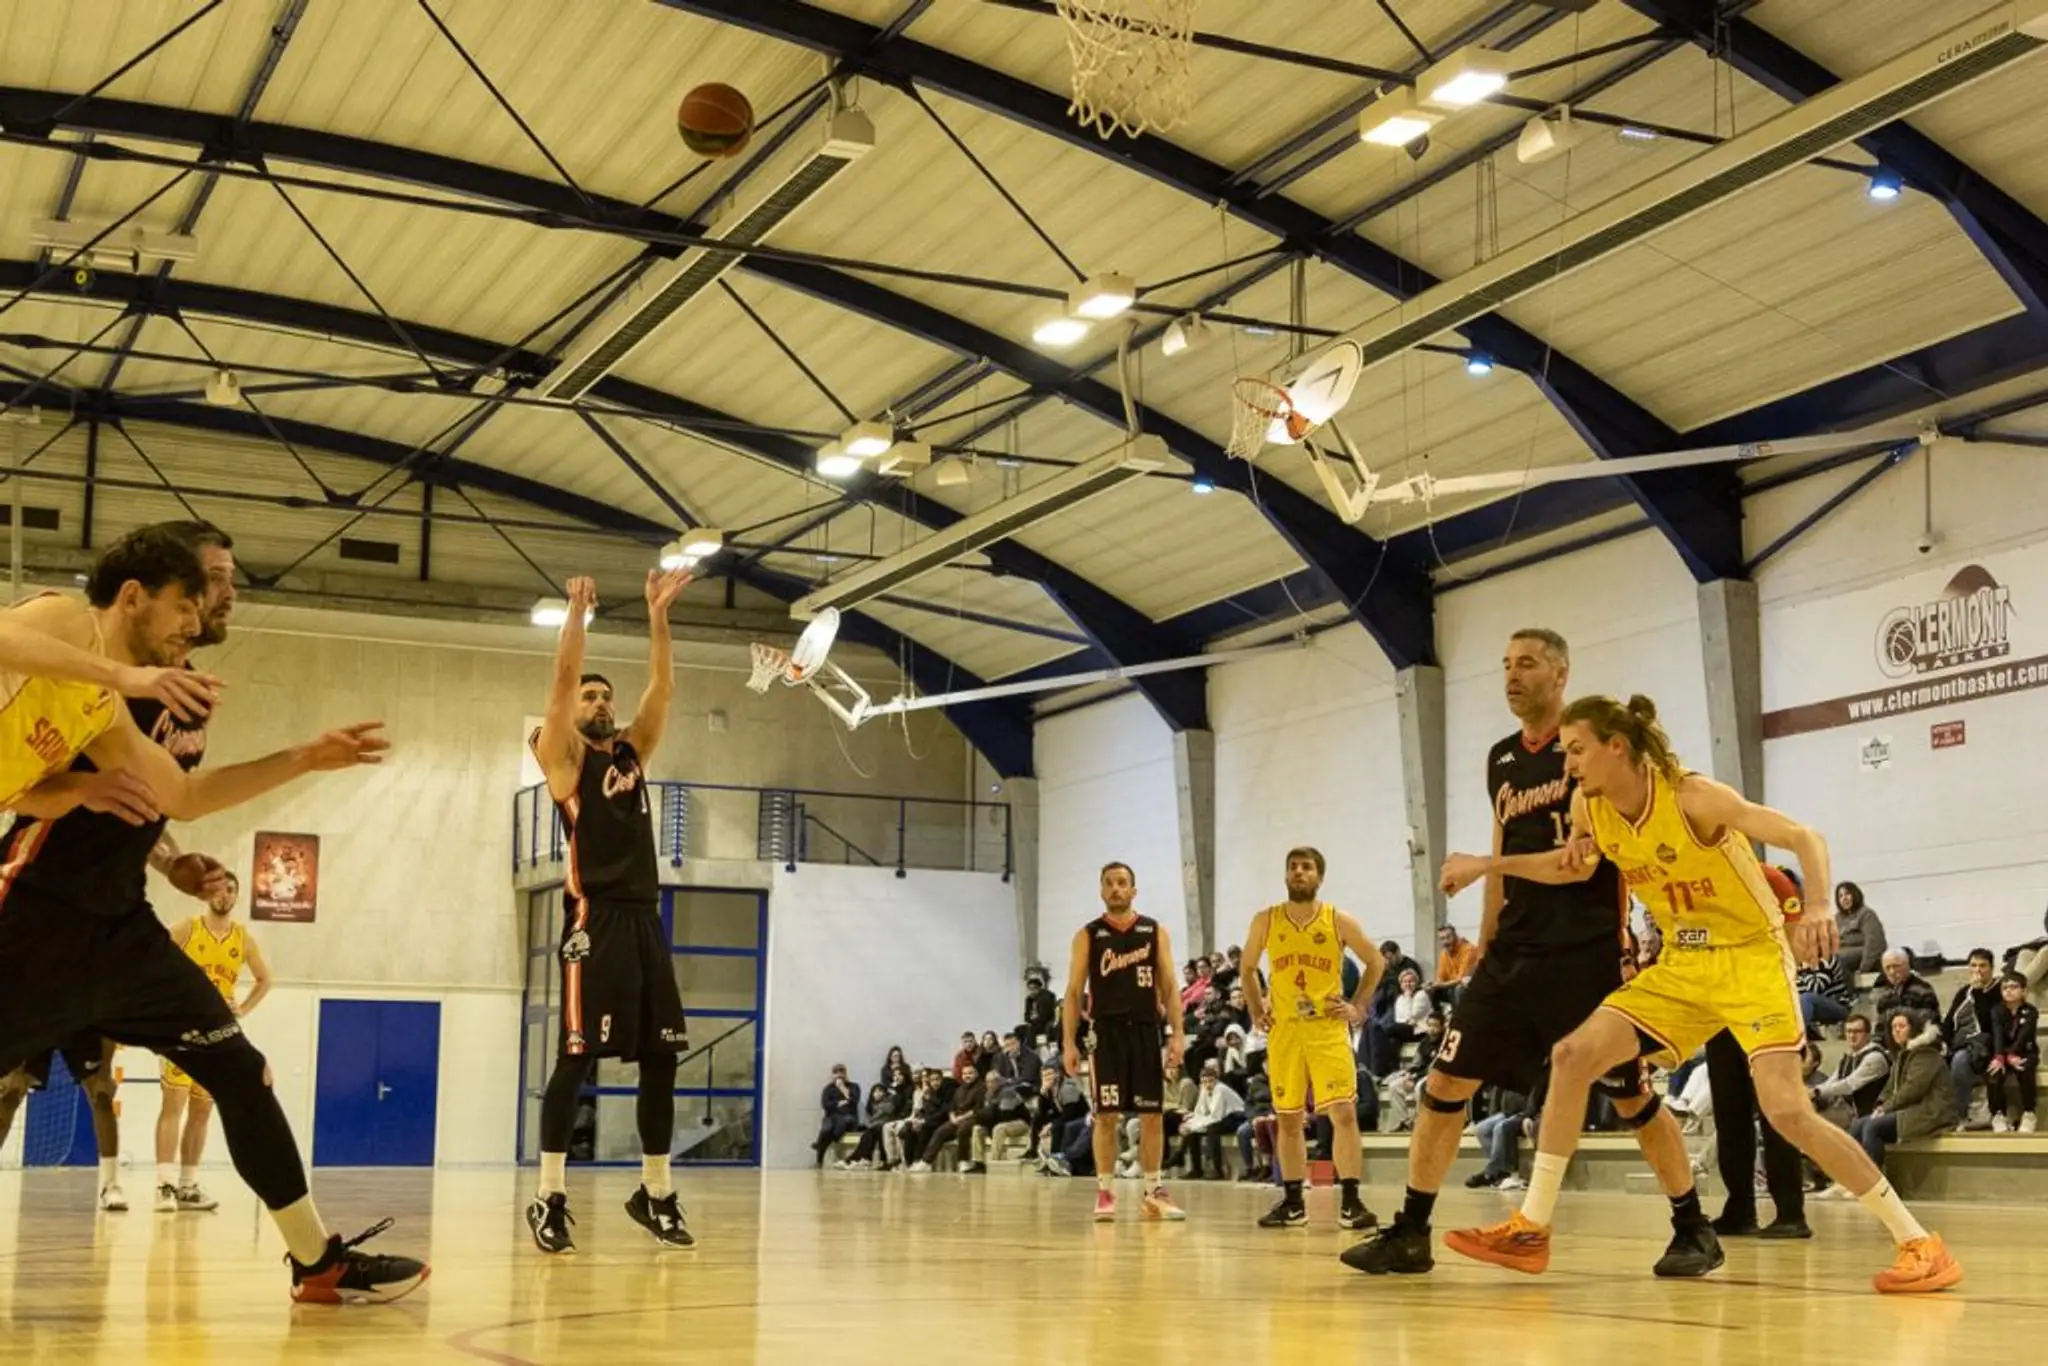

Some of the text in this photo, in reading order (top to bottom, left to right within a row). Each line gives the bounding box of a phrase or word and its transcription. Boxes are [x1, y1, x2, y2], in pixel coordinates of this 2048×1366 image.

[1874, 585, 2011, 680] CLERMONT
[1917, 645, 2006, 671] BASKET
[1848, 664, 2048, 719] www.clermontbasket.com
[1661, 881, 1695, 915] 11
[1136, 965, 1154, 988] 55
[1294, 969, 1307, 992] 4
[600, 1014, 612, 1043] 9
[1100, 1084, 1119, 1107] 55
